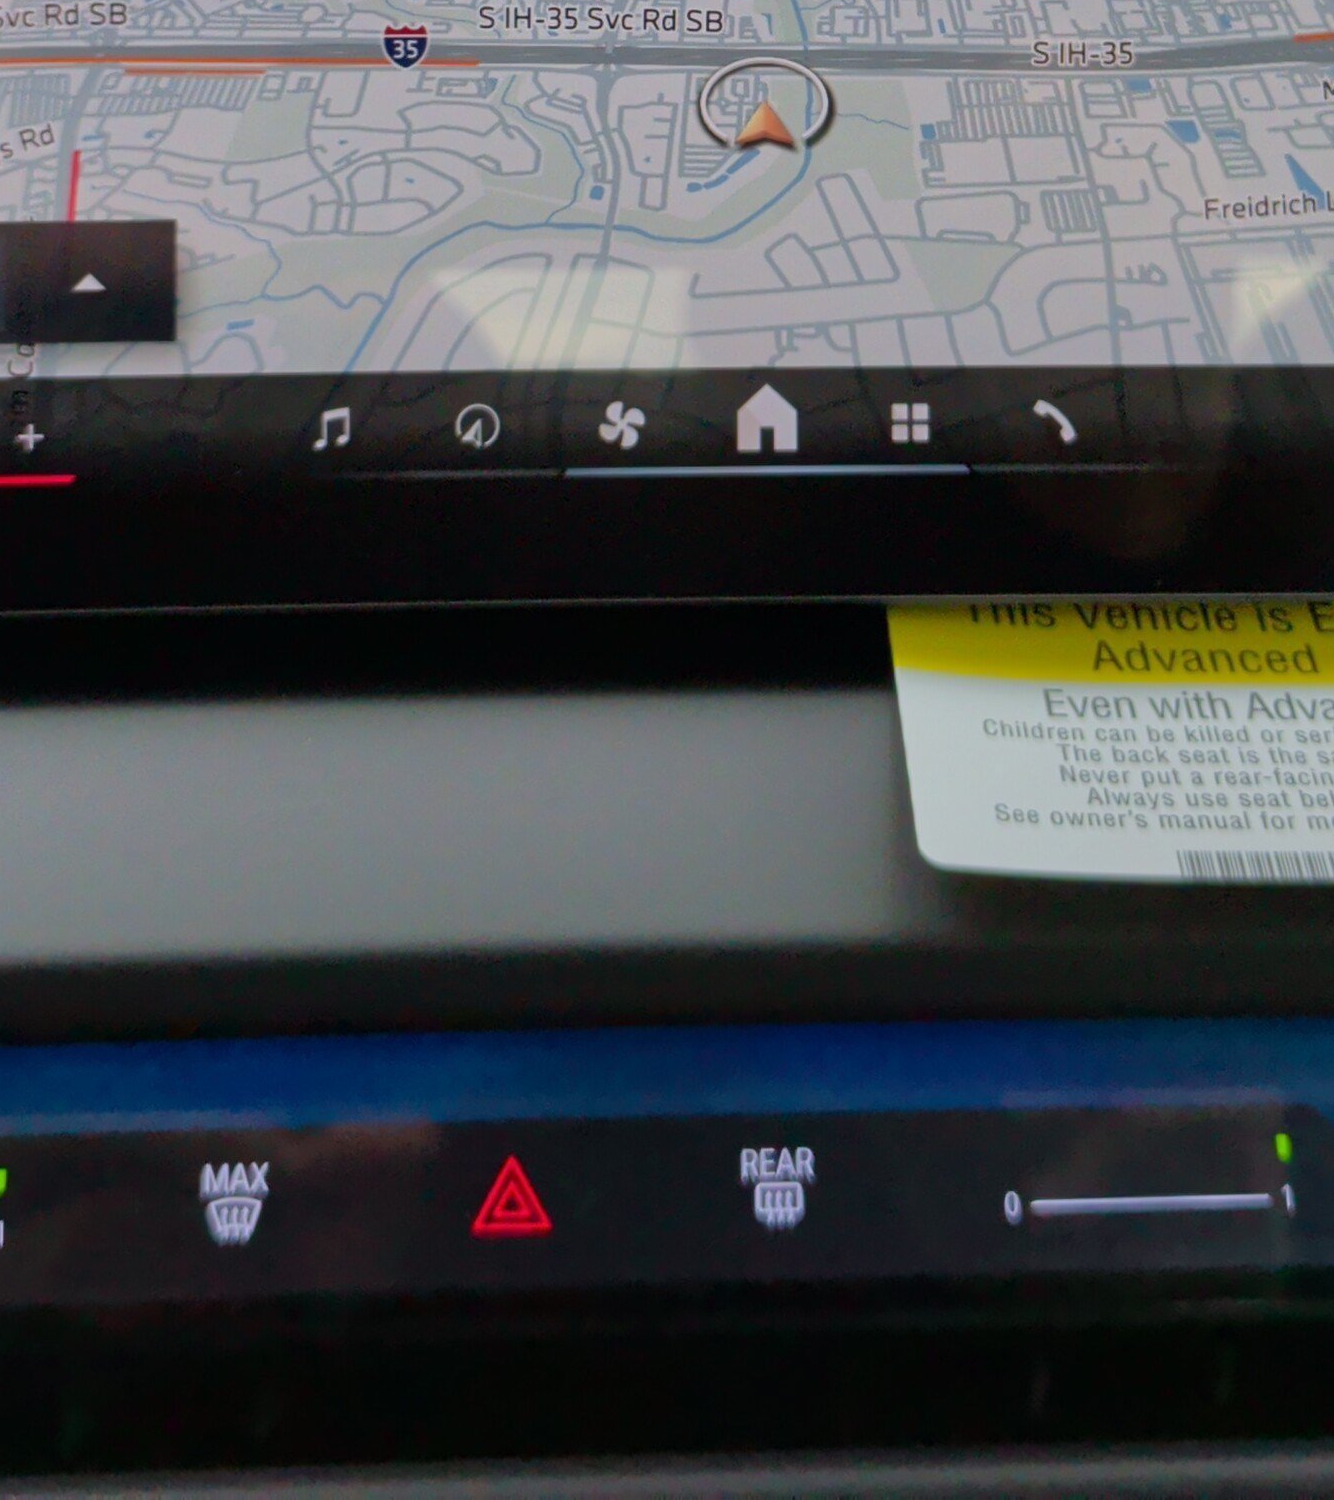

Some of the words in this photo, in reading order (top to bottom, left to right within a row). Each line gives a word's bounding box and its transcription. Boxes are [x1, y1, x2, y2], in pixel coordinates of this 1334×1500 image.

[45, 4, 78, 26] Rd
[91, 3, 128, 26] SB
[479, 7, 495, 29] S
[504, 8, 578, 30] IH-35
[587, 9, 634, 30] Svc
[643, 9, 677, 31] Rd
[686, 11, 724, 32] SB
[393, 41, 419, 59] 35
[1033, 42, 1049, 64] S
[1058, 41, 1133, 65] IH-35
[19, 123, 55, 150] Rd
[1204, 195, 1317, 221] Freidrich
[1094, 640, 1320, 674] Advanced
[1043, 688, 1138, 719] Even
[1147, 688, 1233, 720] with
[983, 719, 1085, 741] Children
[1095, 725, 1137, 742] can
[1147, 722, 1175, 743] be
[1185, 723, 1250, 743] killed
[1261, 728, 1285, 744] or
[1056, 744, 1102, 763] The
[1112, 745, 1169, 764] back
[1179, 747, 1230, 764] seat
[1238, 747, 1259, 765] is
[1269, 747, 1307, 765] the
[1059, 765, 1129, 785] Never
[1141, 769, 1182, 789] put
[1190, 770, 1204, 785] a
[1087, 787, 1175, 811] Always
[1185, 791, 1227, 807] use
[1238, 791, 1289, 808] seat
[995, 803, 1039, 823] See
[1050, 807, 1148, 828] owner's
[1159, 810, 1250, 829] manual
[1260, 811, 1297, 830] for
[740, 1146, 815, 1184] REAR
[200, 1160, 270, 1197] MAX
